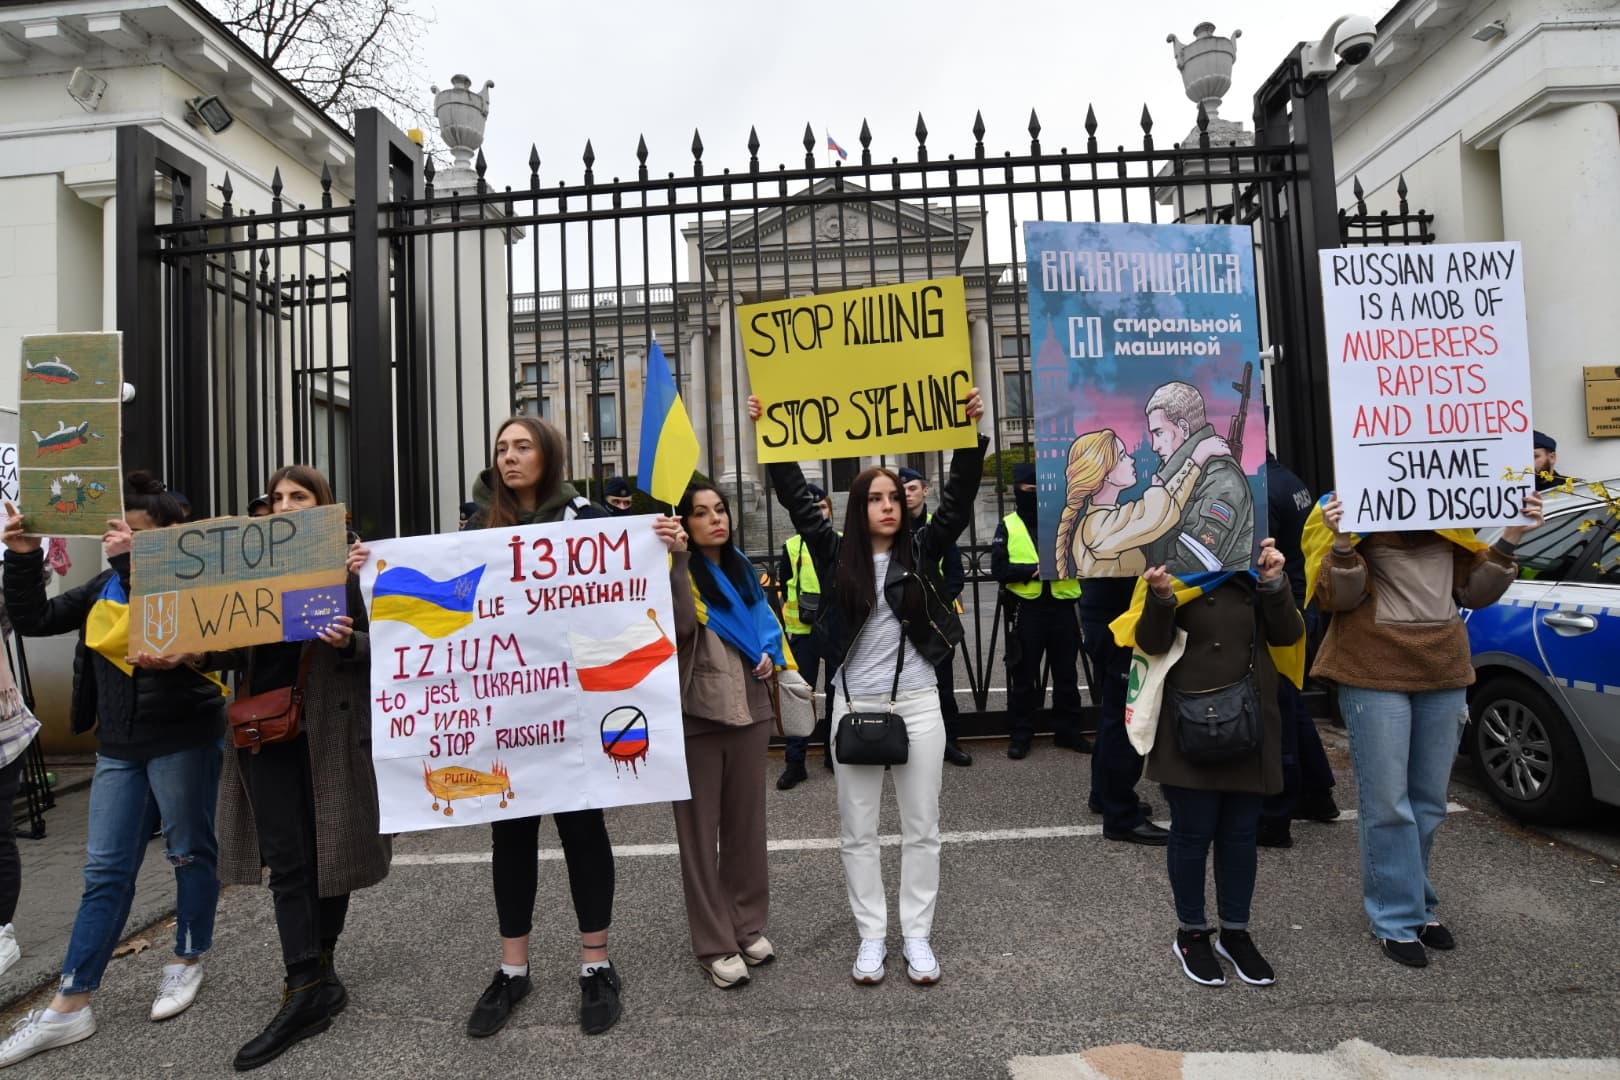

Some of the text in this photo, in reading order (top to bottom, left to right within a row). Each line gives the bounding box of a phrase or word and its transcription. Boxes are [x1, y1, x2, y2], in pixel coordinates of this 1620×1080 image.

[1333, 249, 1515, 286] RUSSIAN ARMY
[749, 286, 944, 357] STOP KILLING
[1360, 287, 1503, 321] IS A MOB OF
[1113, 313, 1242, 338] стиральной
[1343, 324, 1499, 363] MURDERERS
[1114, 336, 1221, 356] машиной
[1377, 363, 1487, 396] RAPISTS
[762, 370, 972, 448] STOP STEALING
[1353, 400, 1529, 438] AND LOOTERS
[1387, 448, 1489, 482] SHAME
[1357, 485, 1531, 523] AND DISGUST
[175, 517, 297, 580] STOP
[191, 587, 280, 638] WAR
[478, 577, 647, 619] ЦЕ УКРАЇНА!!!
[376, 690, 406, 713] to
[417, 678, 459, 715] jest
[390, 714, 415, 738] NO
[429, 732, 476, 758] STOP
[444, 772, 478, 784] PUTIN
